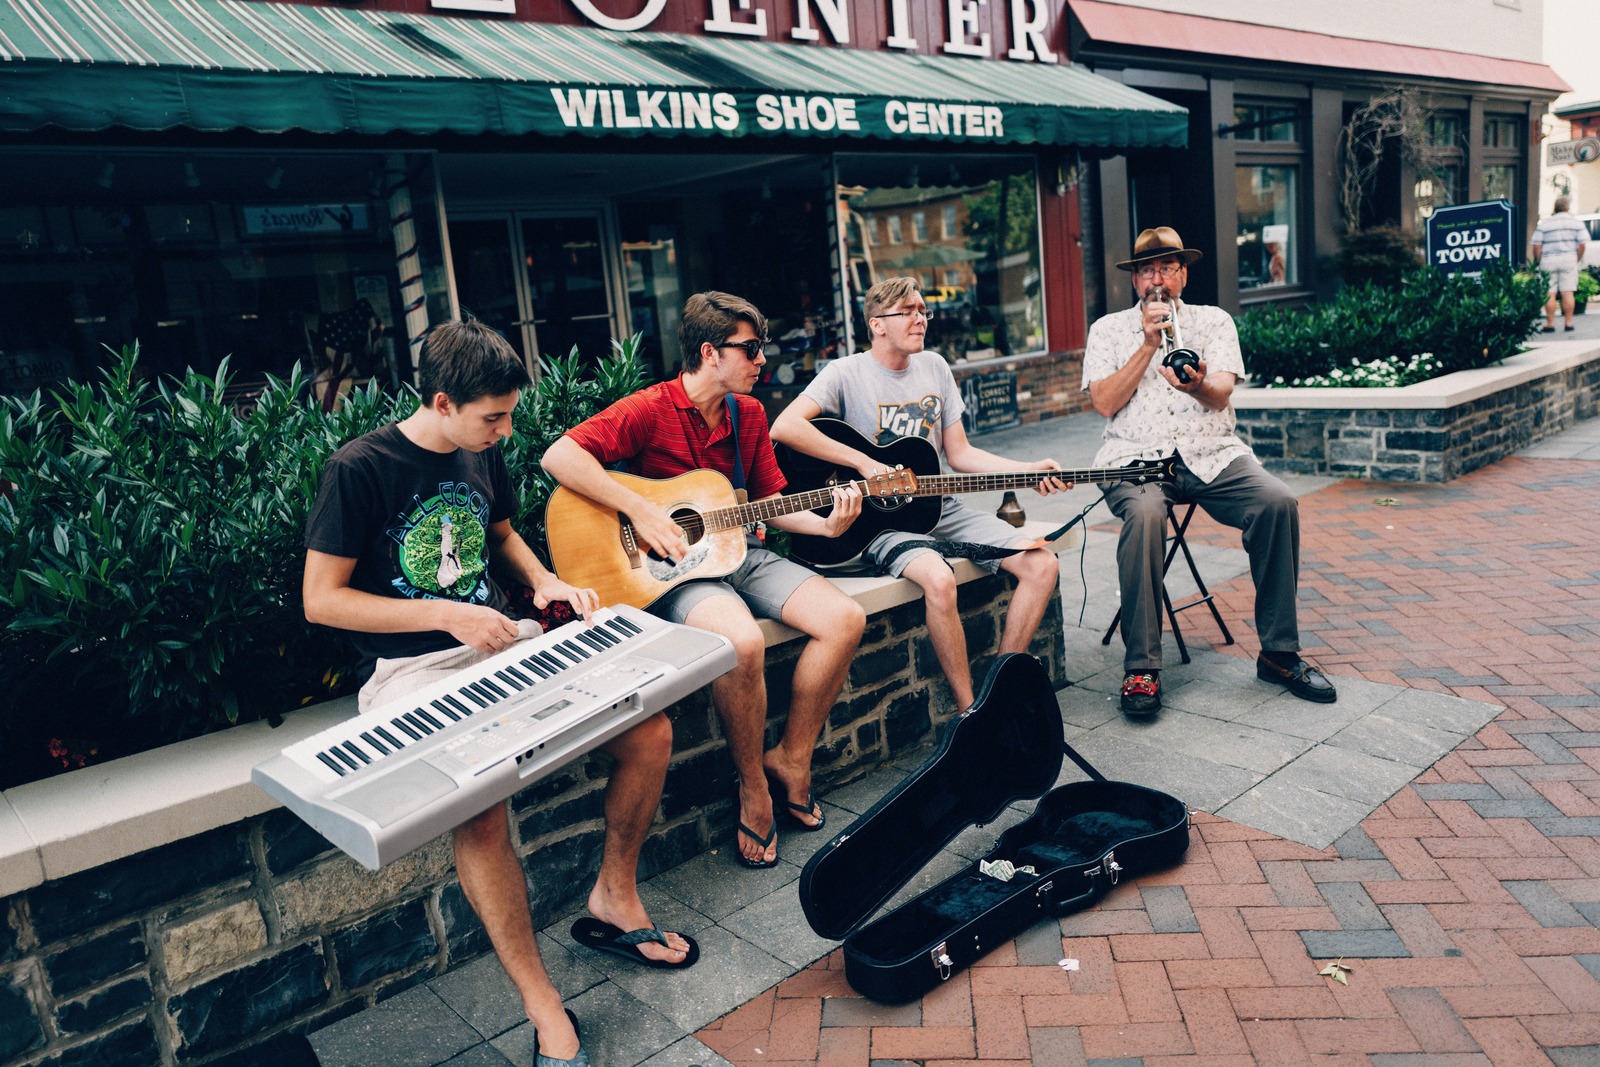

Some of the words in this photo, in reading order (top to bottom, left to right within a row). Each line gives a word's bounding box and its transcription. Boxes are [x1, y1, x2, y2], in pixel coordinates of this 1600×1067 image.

[550, 88, 740, 131] WILKINS
[756, 94, 861, 131] SHOE
[885, 100, 1004, 137] CENTER
[1436, 243, 1502, 264] TOWN
[1446, 228, 1491, 247] OLD
[880, 405, 924, 437] VCU
[386, 494, 439, 547] ALL
